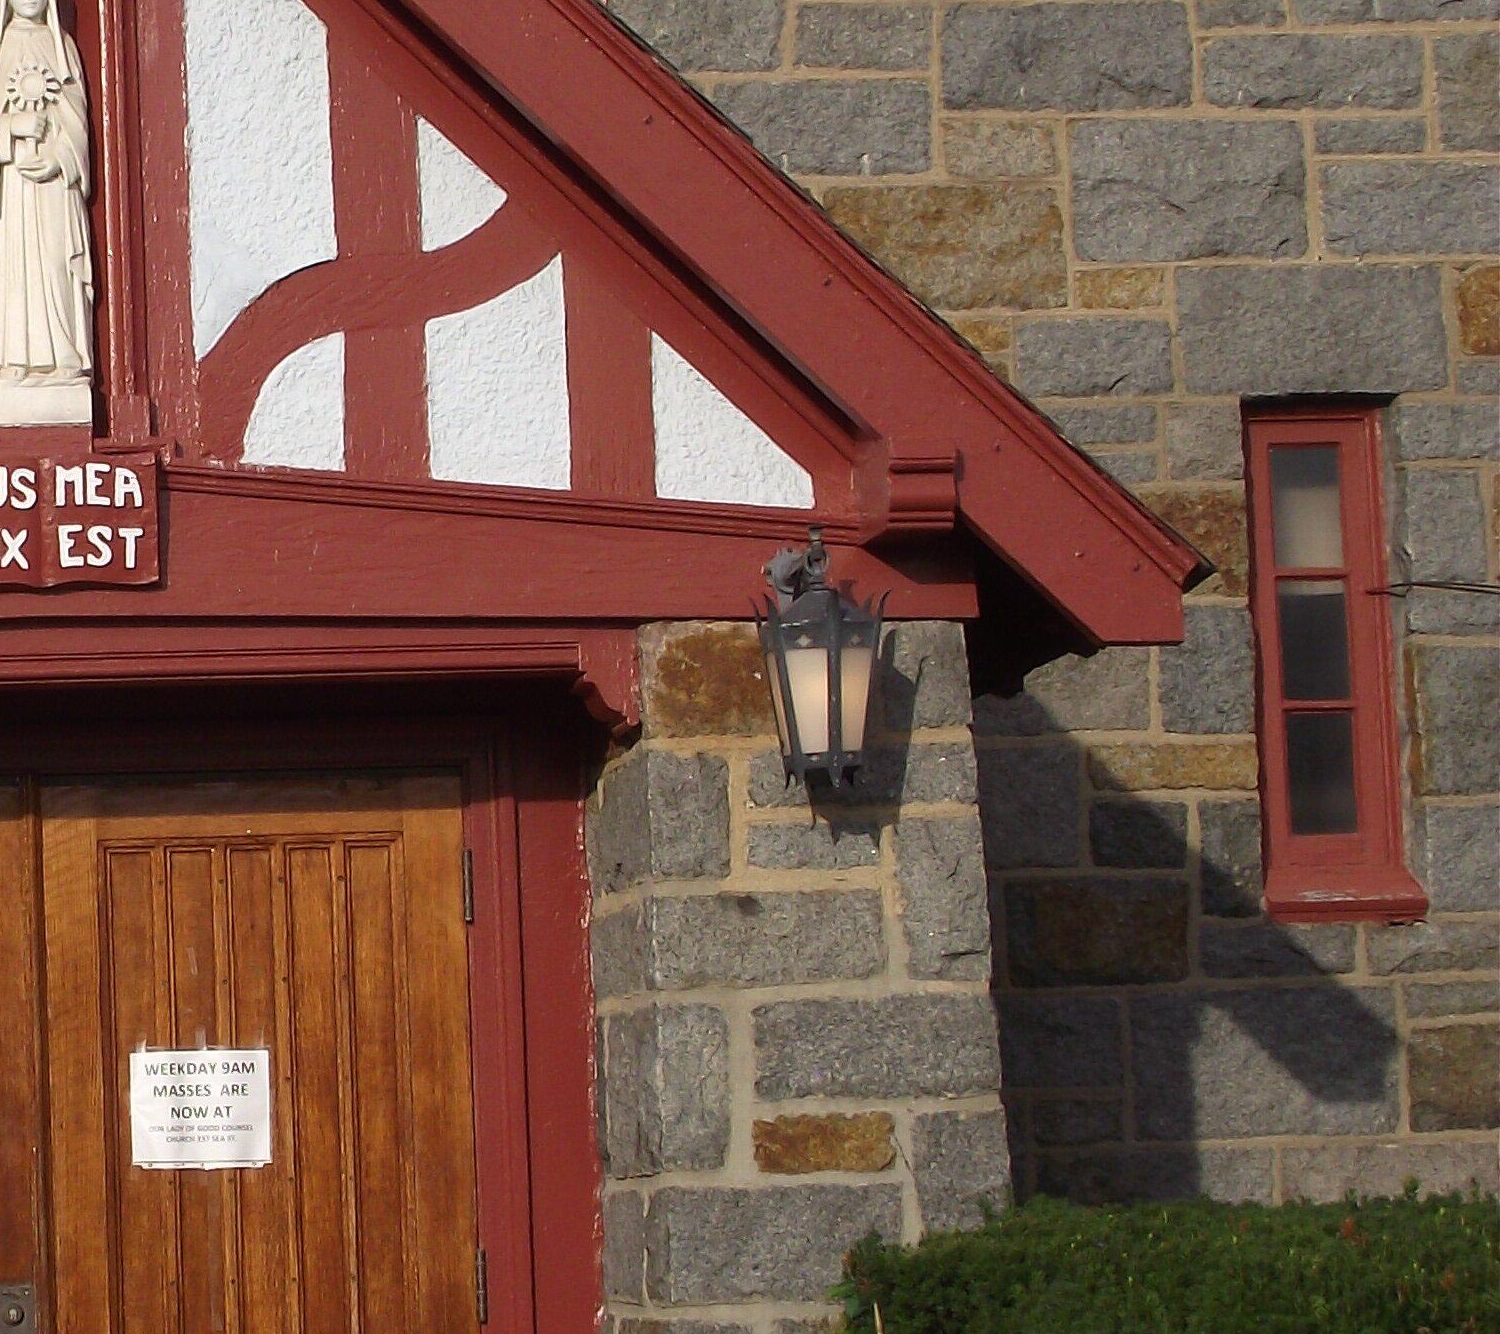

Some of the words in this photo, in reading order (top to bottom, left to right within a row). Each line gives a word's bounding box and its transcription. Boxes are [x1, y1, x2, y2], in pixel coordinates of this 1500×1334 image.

[55, 463, 143, 507] MEA
[58, 524, 144, 570] EST
[145, 1062, 217, 1076] WEEKDAY
[222, 1062, 255, 1075] 9AM
[153, 1084, 211, 1097] MASSES
[220, 1083, 249, 1096] ARE
[171, 1106, 208, 1119] NOW
[214, 1106, 233, 1118] AT
[197, 1124, 219, 1132] GOOD
[166, 1135, 195, 1143] CHURCH
